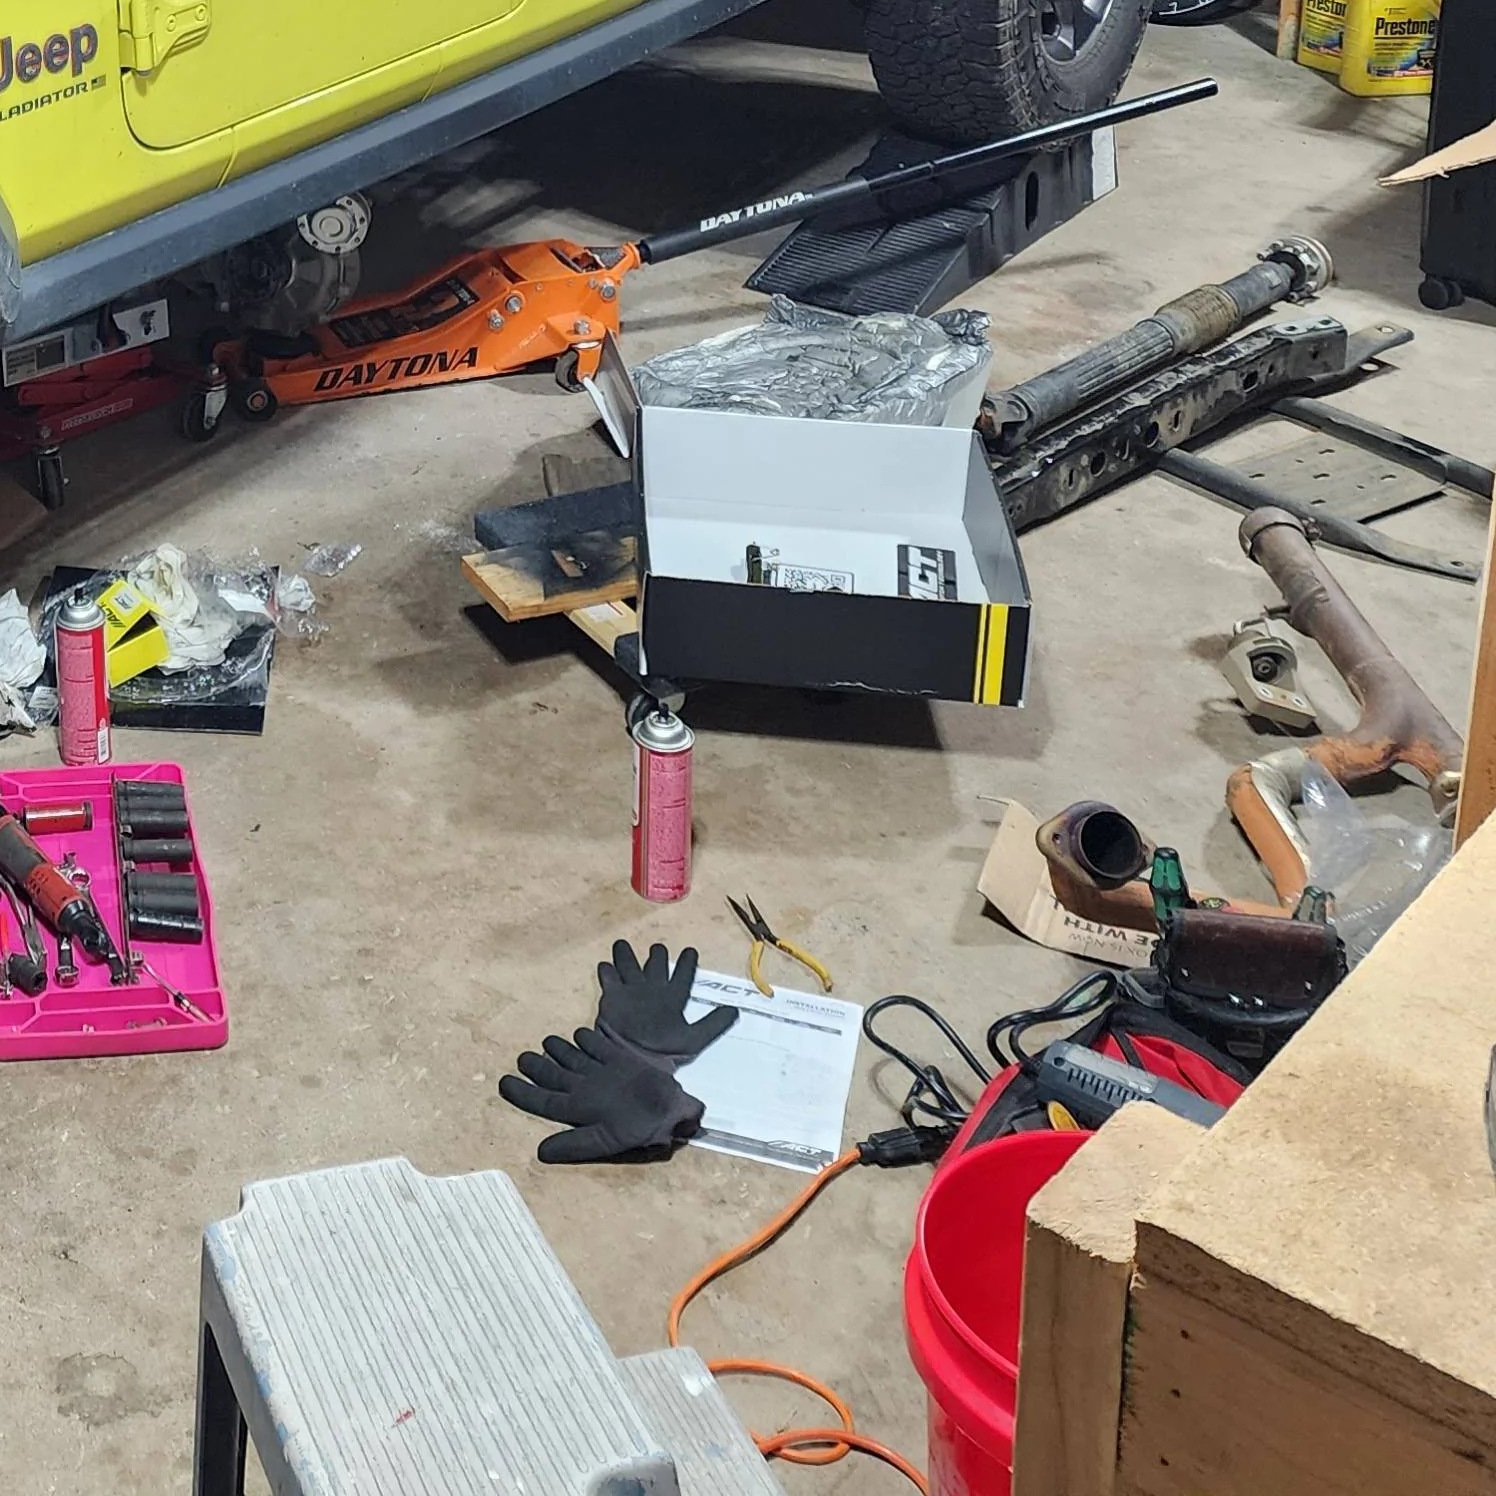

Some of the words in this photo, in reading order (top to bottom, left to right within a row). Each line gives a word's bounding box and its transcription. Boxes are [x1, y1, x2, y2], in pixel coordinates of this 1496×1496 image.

[1375, 17, 1436, 36] Prestone
[700, 191, 806, 232] DAYTONA
[313, 346, 479, 392] DAYTONA
[1064, 916, 1128, 942] WITH
[1127, 946, 1148, 961] OX
